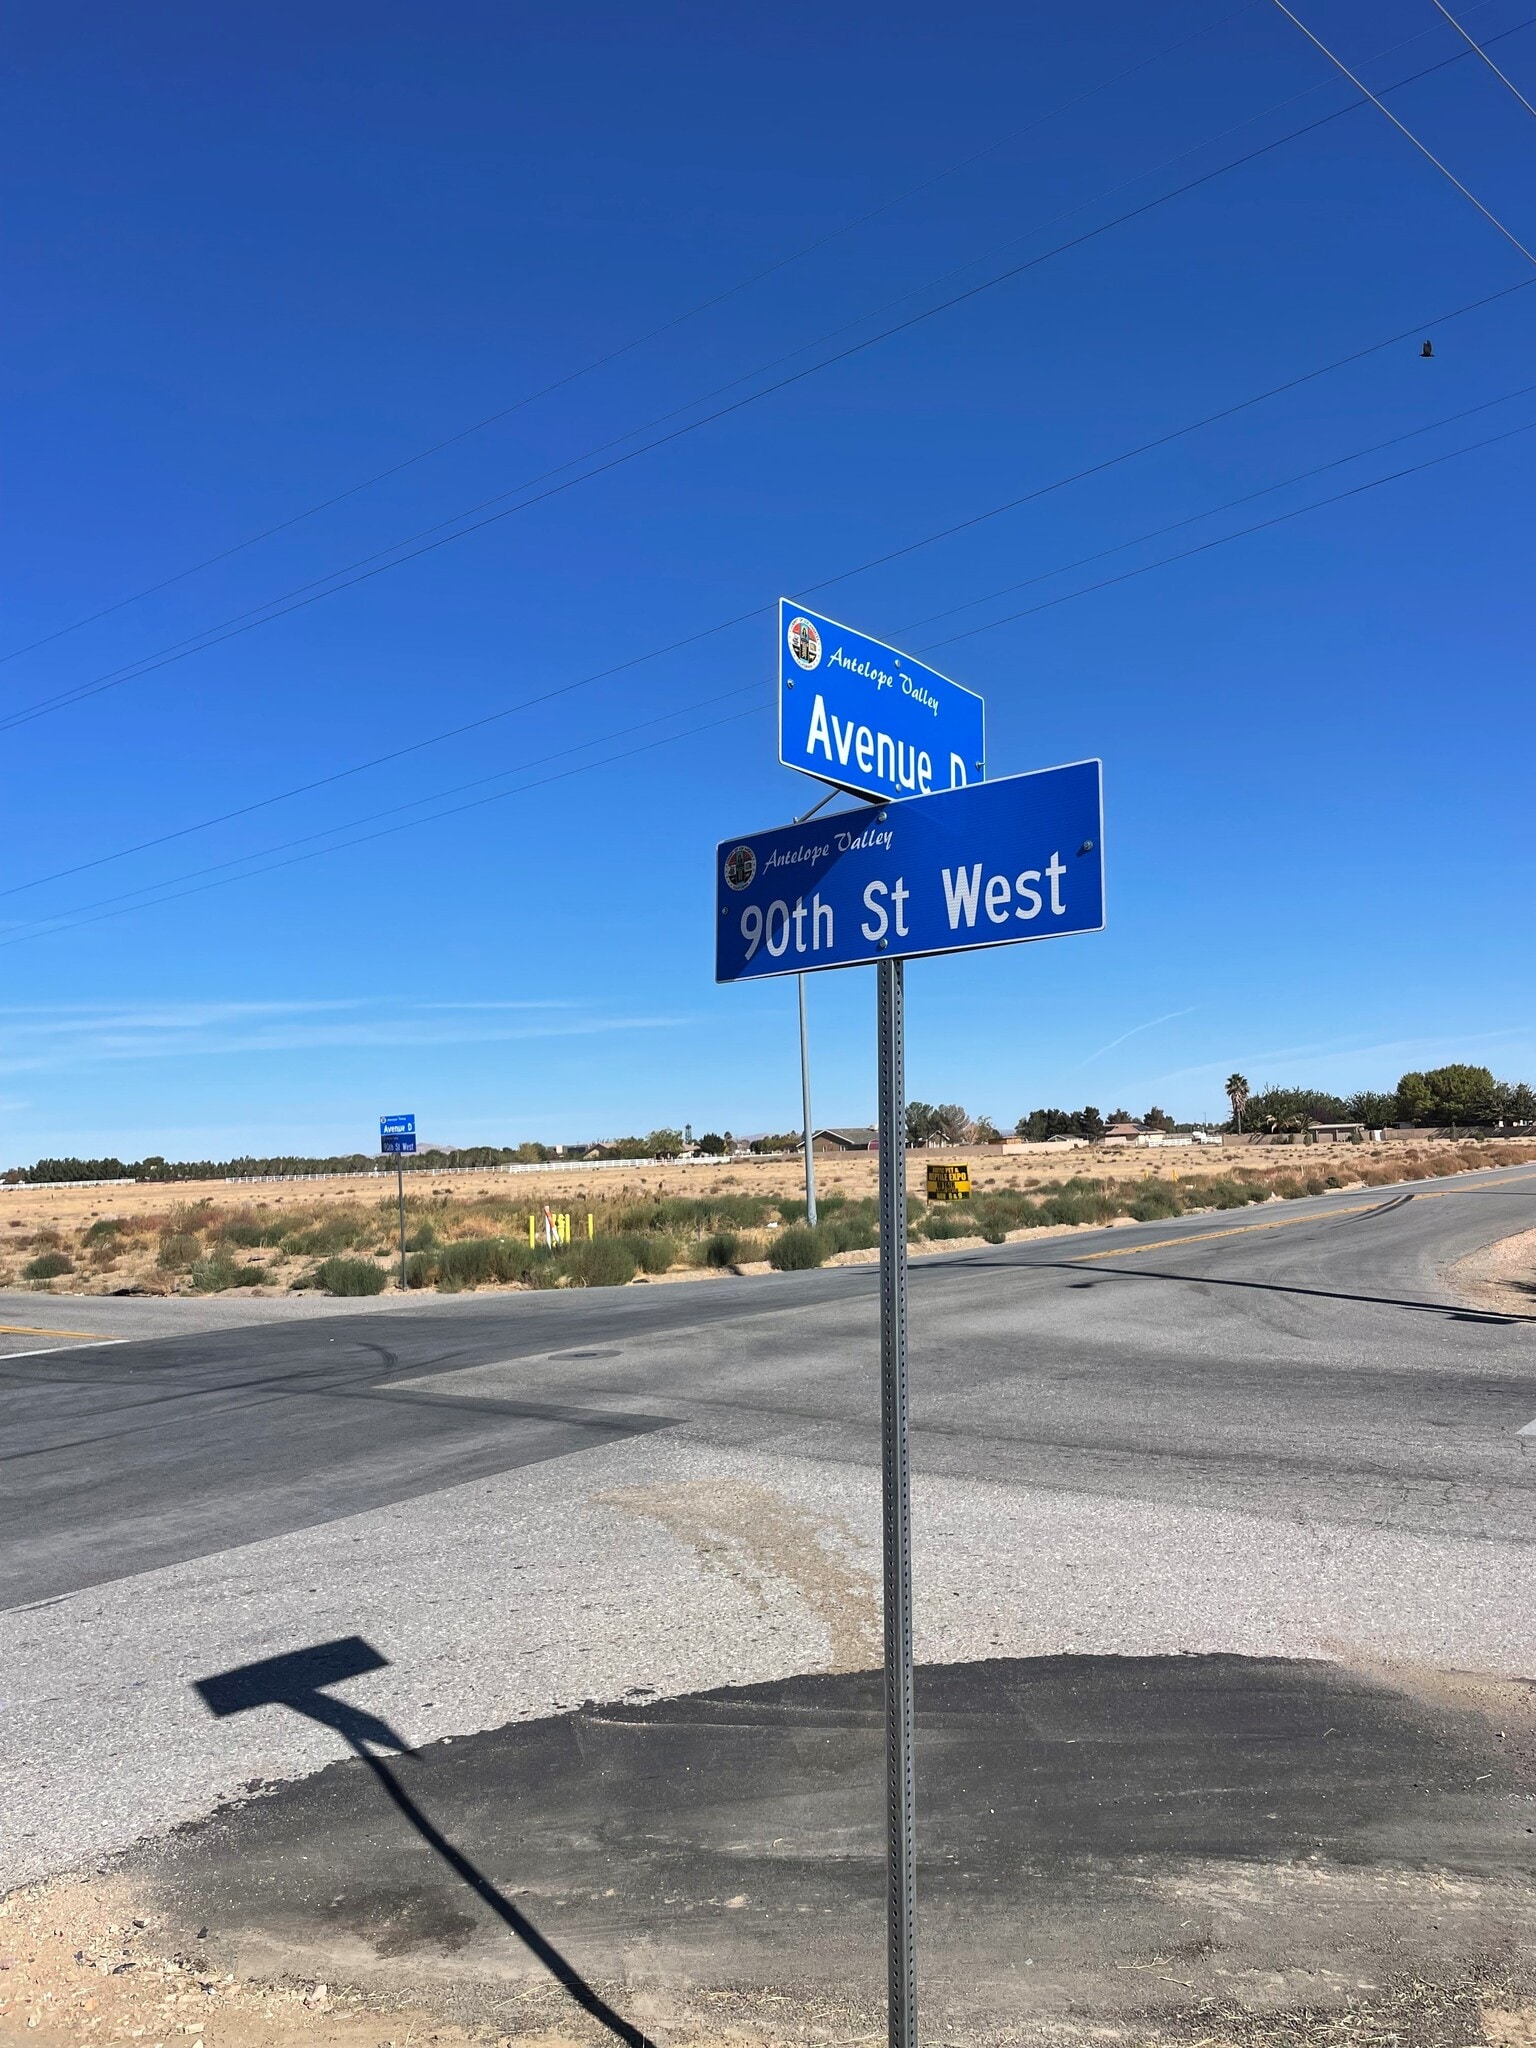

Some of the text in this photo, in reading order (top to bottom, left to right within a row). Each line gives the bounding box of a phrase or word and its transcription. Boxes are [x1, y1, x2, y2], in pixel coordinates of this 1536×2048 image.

[827, 647, 939, 716] Antelope Valley
[806, 694, 932, 795] Avenue
[762, 843, 830, 875] Antelope
[834, 829, 893, 852] Valley
[740, 851, 1067, 960] 90th St West
[384, 1122, 412, 1134] Avenue D
[395, 1142, 401, 1151] St
[402, 1142, 414, 1150] West
[928, 1172, 966, 1181] REPTILE EXPO
